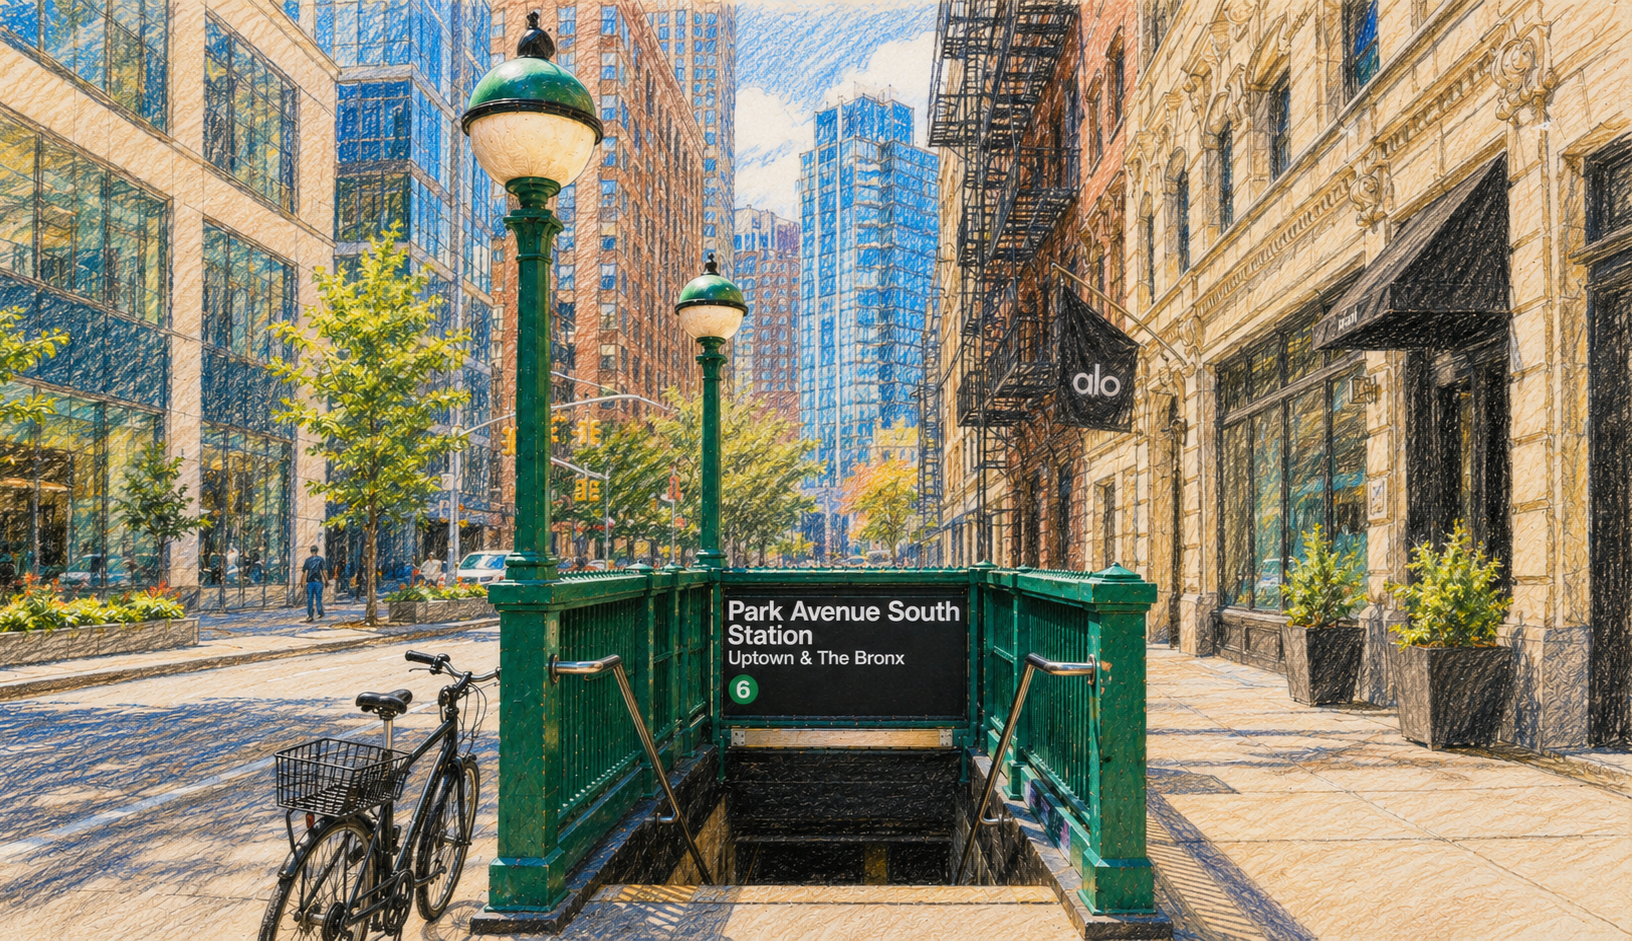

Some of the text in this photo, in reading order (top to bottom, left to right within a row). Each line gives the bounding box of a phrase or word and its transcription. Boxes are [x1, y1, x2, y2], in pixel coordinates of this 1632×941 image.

[1073, 363, 1121, 397] alo
[728, 600, 960, 622] Park Avenue South
[728, 624, 813, 645] Station
[728, 650, 905, 668] Uptown & The Bronx
[736, 680, 751, 698] 6
